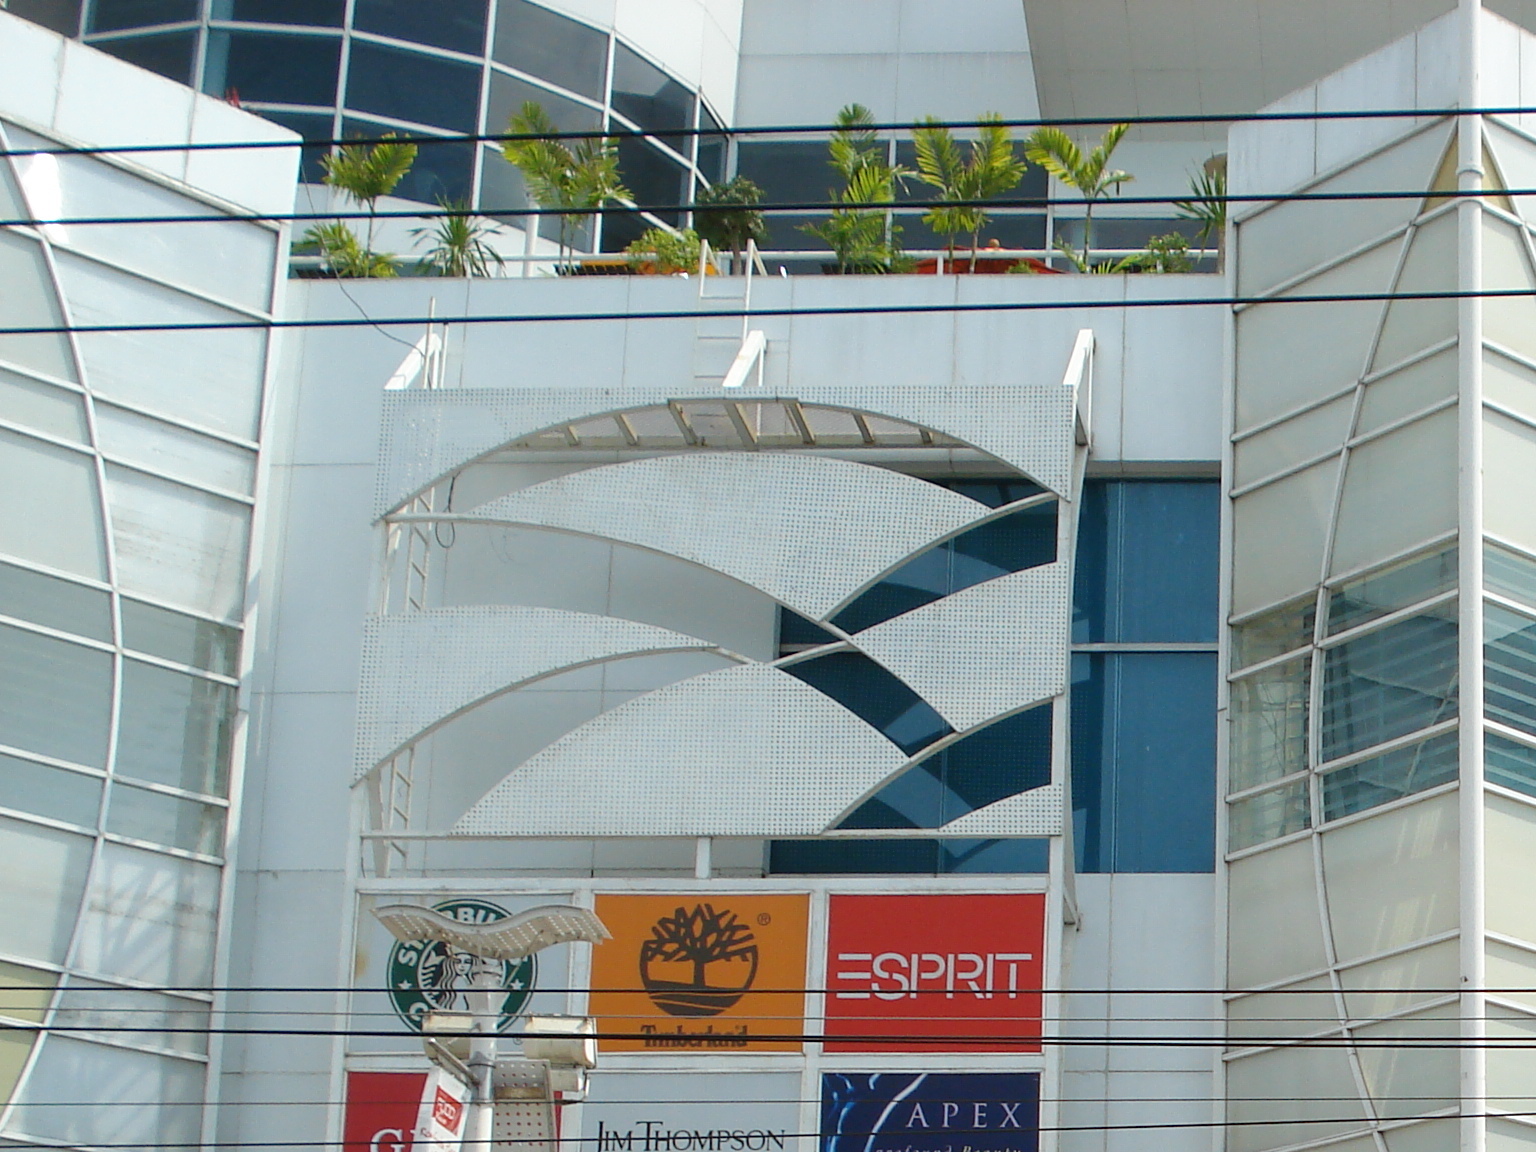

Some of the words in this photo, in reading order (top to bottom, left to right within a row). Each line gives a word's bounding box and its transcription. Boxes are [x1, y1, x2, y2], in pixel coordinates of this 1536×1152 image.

[836, 952, 1033, 1001] ESPRIT
[640, 1024, 748, 1049] Timberland
[905, 1102, 1022, 1129] APEX
